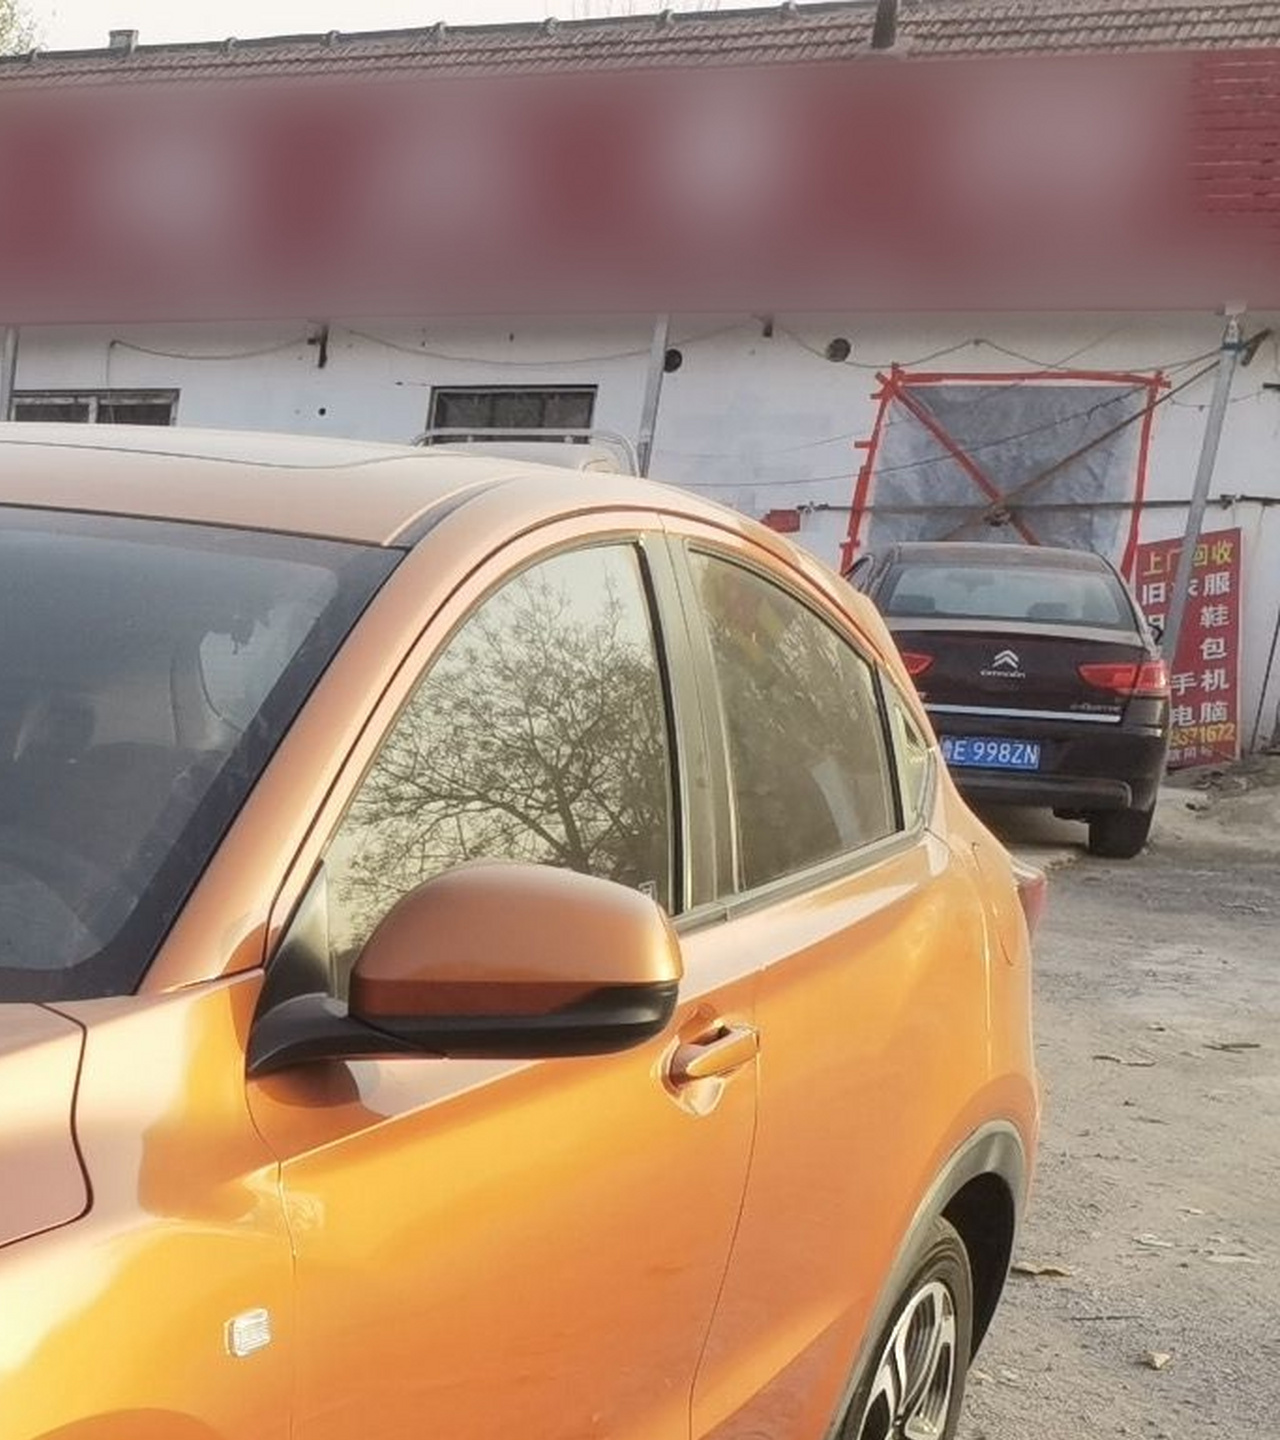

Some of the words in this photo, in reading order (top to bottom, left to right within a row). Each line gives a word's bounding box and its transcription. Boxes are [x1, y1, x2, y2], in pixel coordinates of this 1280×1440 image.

[1200, 637, 1227, 660] 包
[1171, 669, 1229, 696] 手机
[1169, 700, 1228, 728] 电脑
